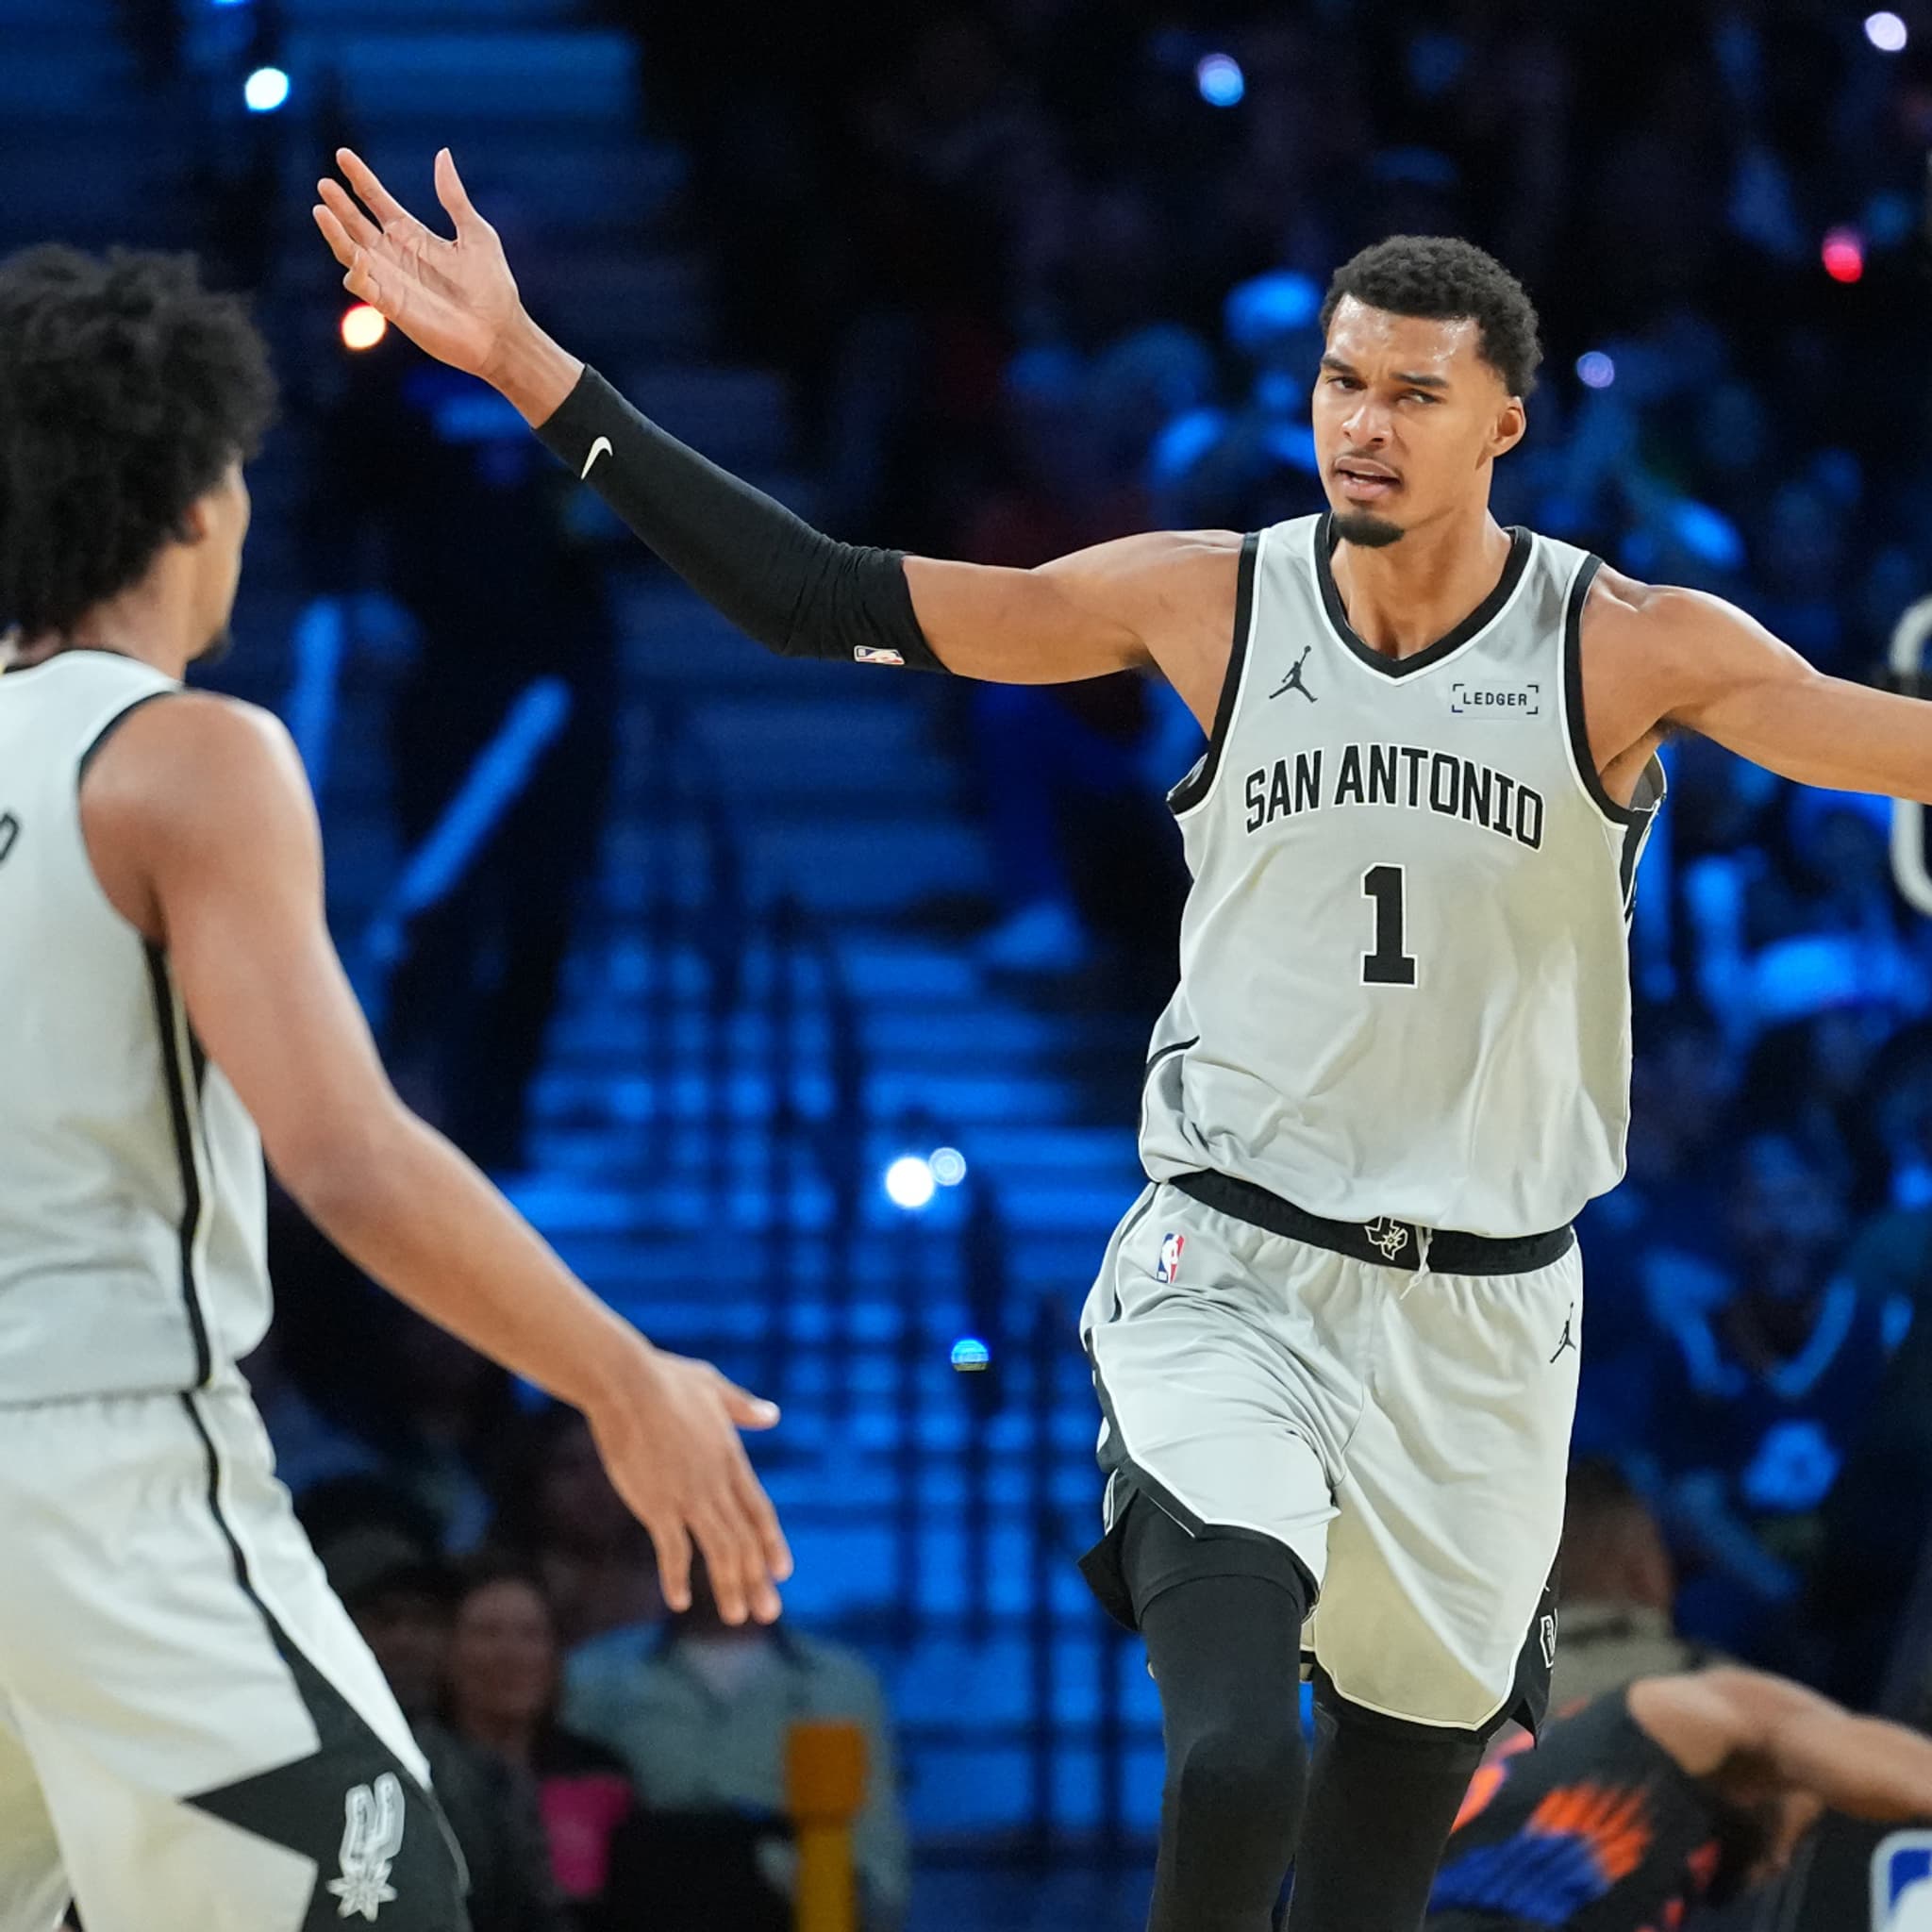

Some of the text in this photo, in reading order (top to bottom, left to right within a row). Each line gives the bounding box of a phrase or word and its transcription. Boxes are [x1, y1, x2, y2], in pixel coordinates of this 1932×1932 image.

[1462, 691, 1528, 707] LEDGER
[1244, 742, 1545, 852] SAN ANTONIO
[1360, 862, 1419, 989] 1
